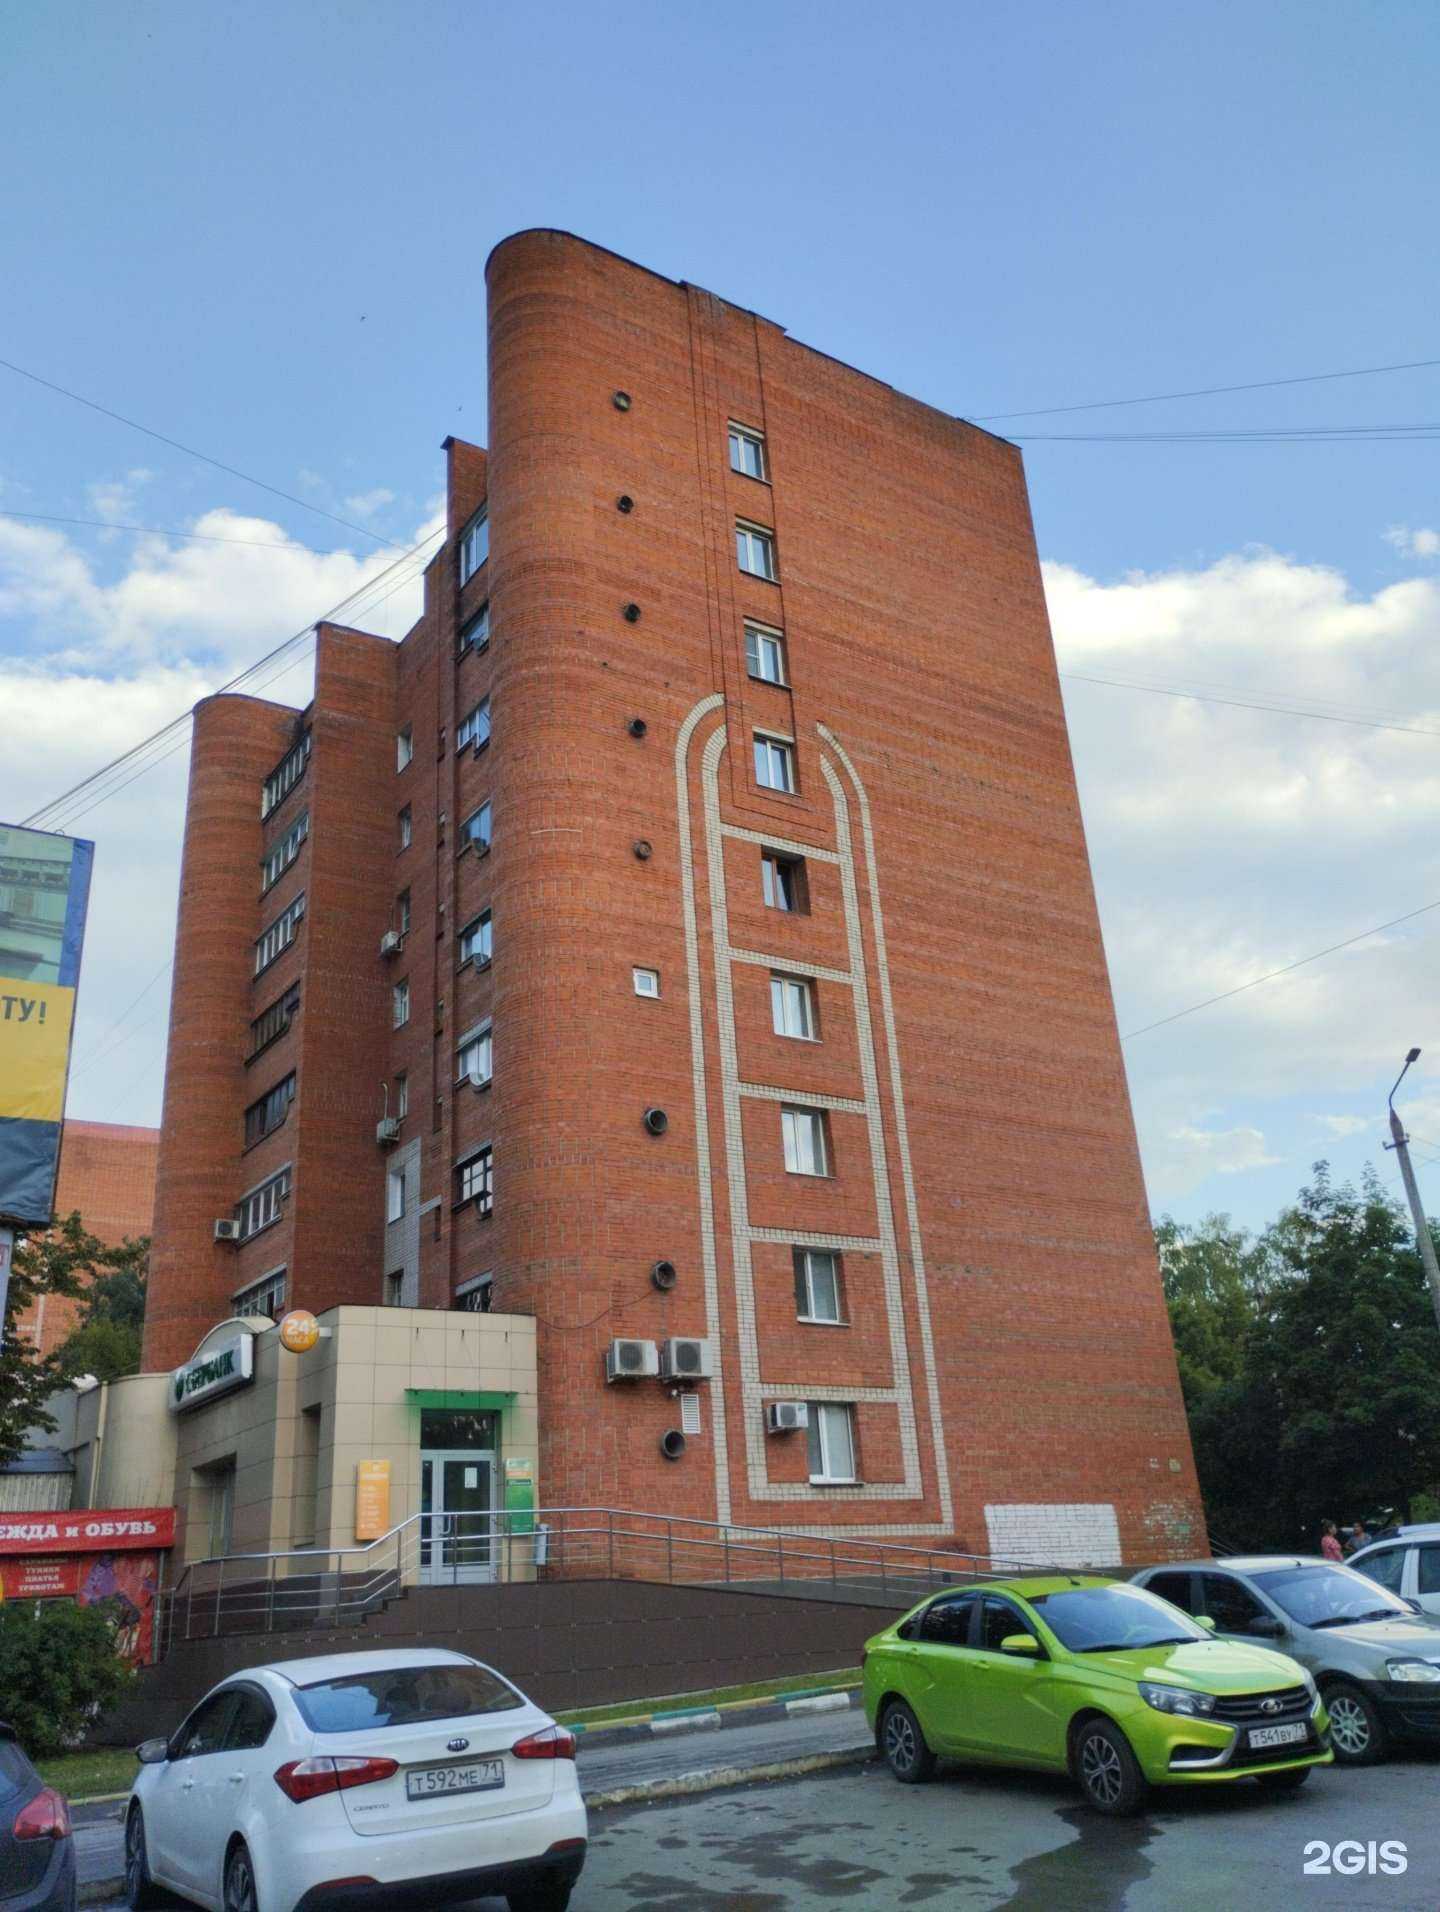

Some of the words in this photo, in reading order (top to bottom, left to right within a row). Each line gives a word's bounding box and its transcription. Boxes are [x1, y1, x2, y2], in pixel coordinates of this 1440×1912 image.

[2, 995, 46, 1024] ТУ!
[286, 1319, 311, 1335] 24
[66, 1527, 78, 1537] и
[85, 1521, 156, 1537] ОБУВЬ
